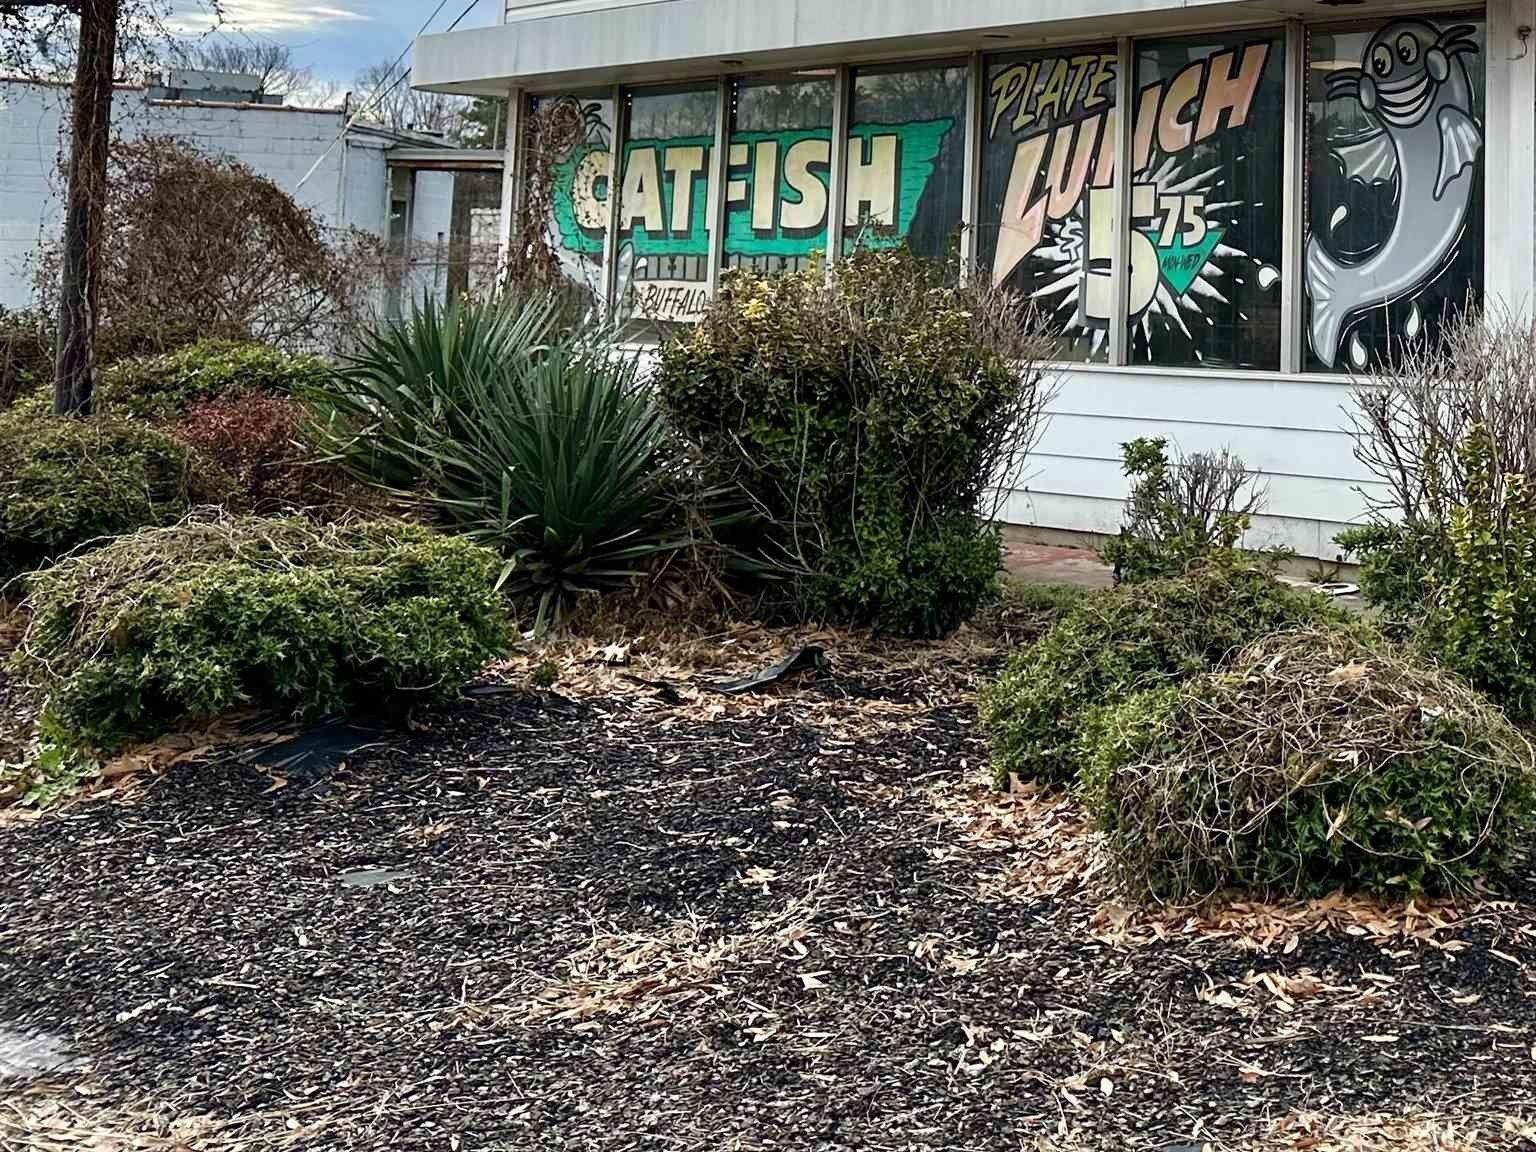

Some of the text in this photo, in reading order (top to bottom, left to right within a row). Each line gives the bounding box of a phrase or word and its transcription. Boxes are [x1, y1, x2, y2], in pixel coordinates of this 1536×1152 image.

[989, 54, 1118, 140] PLATE
[572, 134, 898, 232] CATFISH
[991, 43, 1270, 289] LUNCH
[644, 284, 707, 316] BUFFALO
